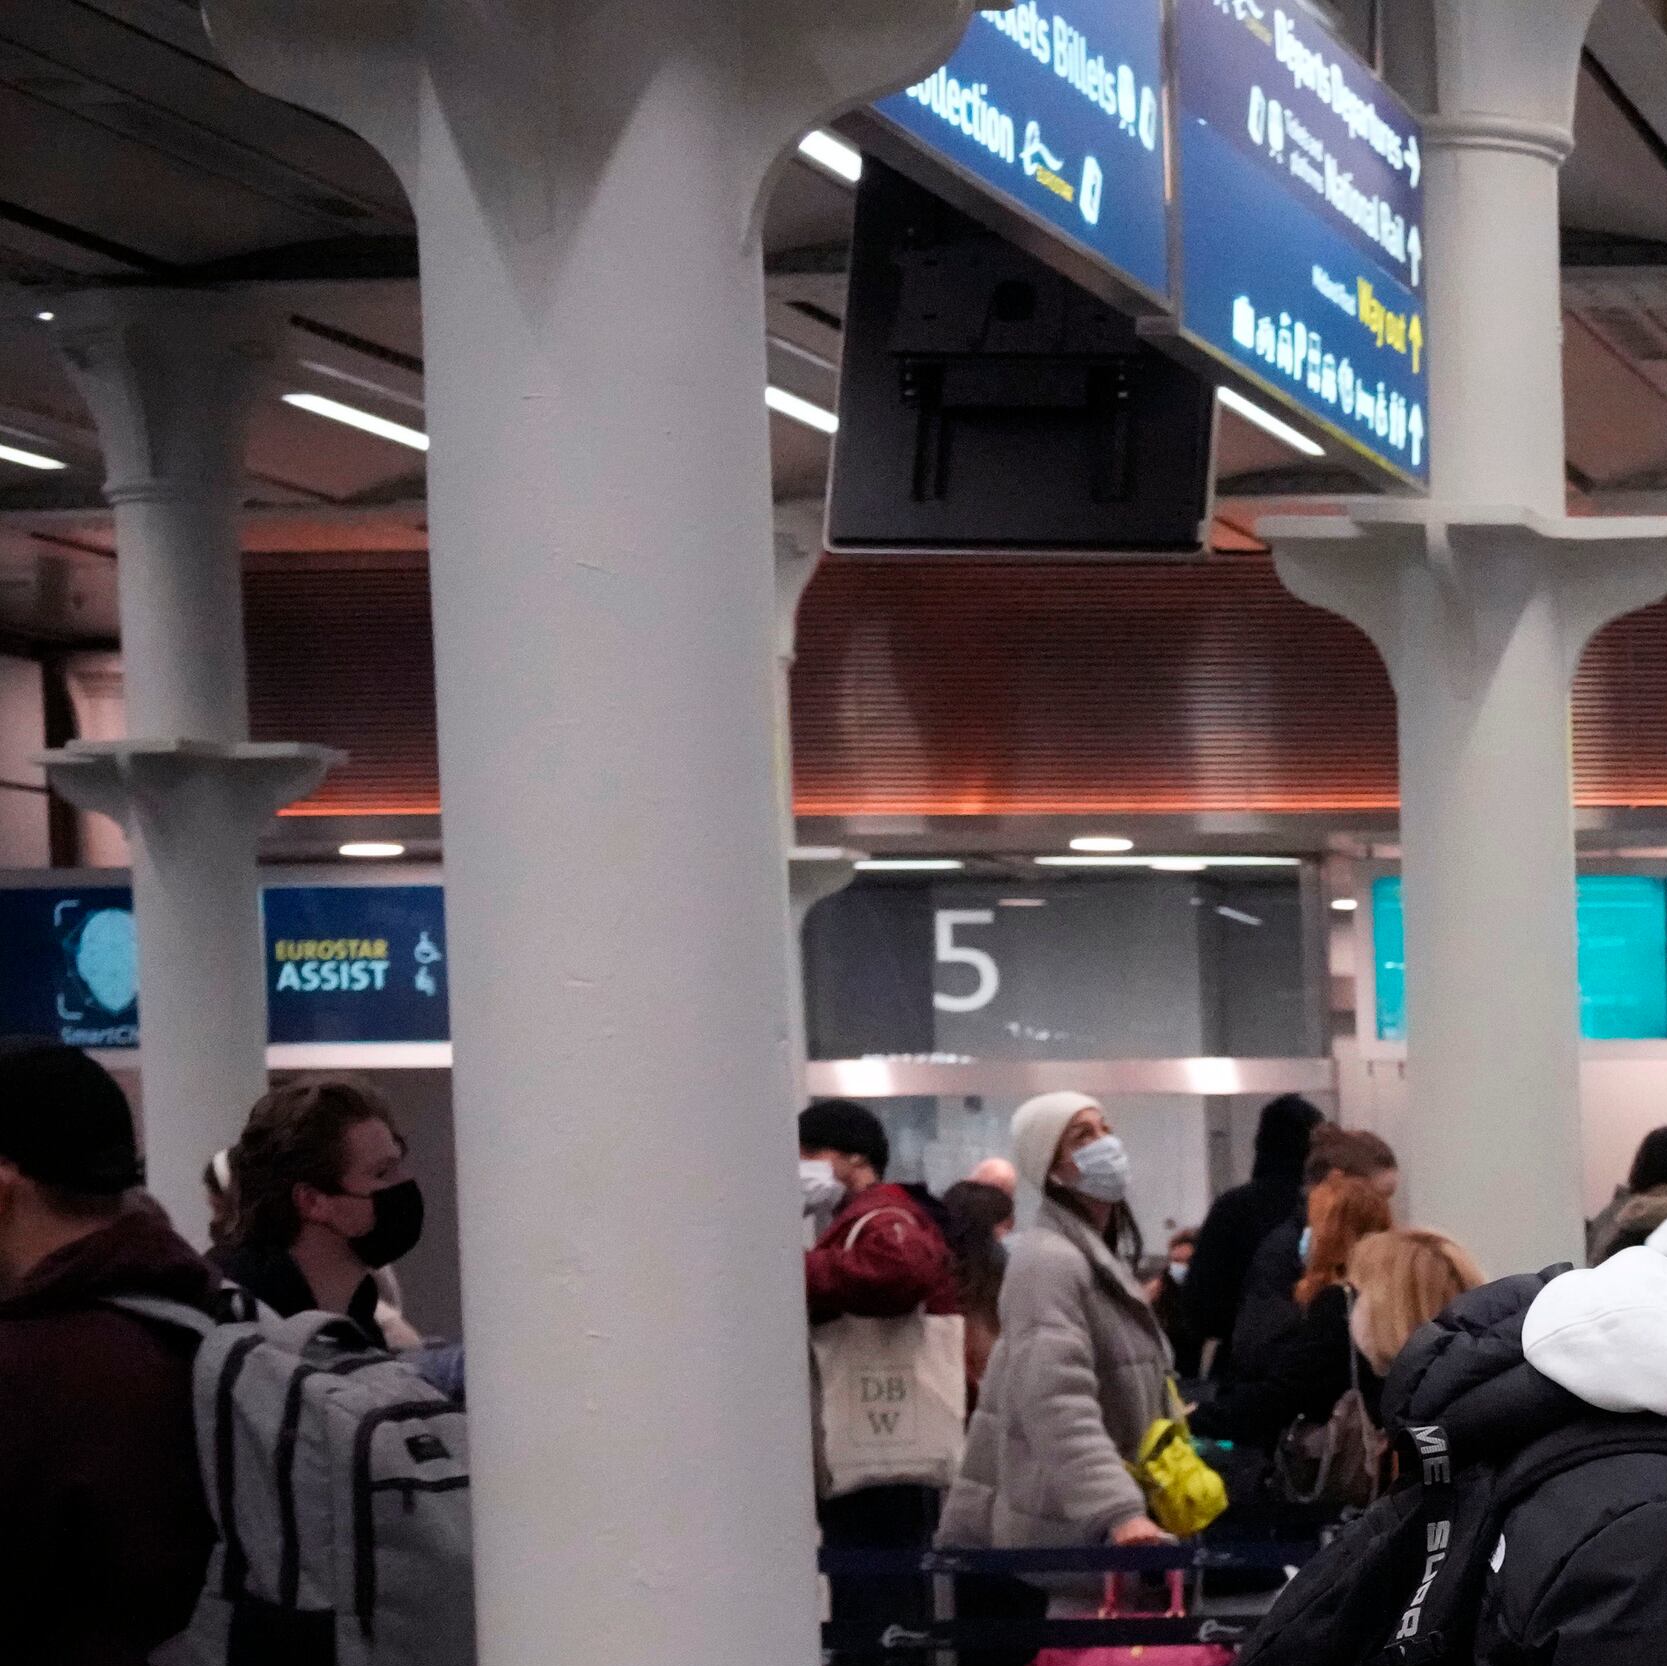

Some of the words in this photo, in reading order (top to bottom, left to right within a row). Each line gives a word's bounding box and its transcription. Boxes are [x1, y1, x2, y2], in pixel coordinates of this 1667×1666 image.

[1053, 16, 1117, 115] Billets
[275, 938, 389, 961] EUROSTAR
[276, 960, 390, 991] ASSIST
[932, 910, 1000, 1012] 5
